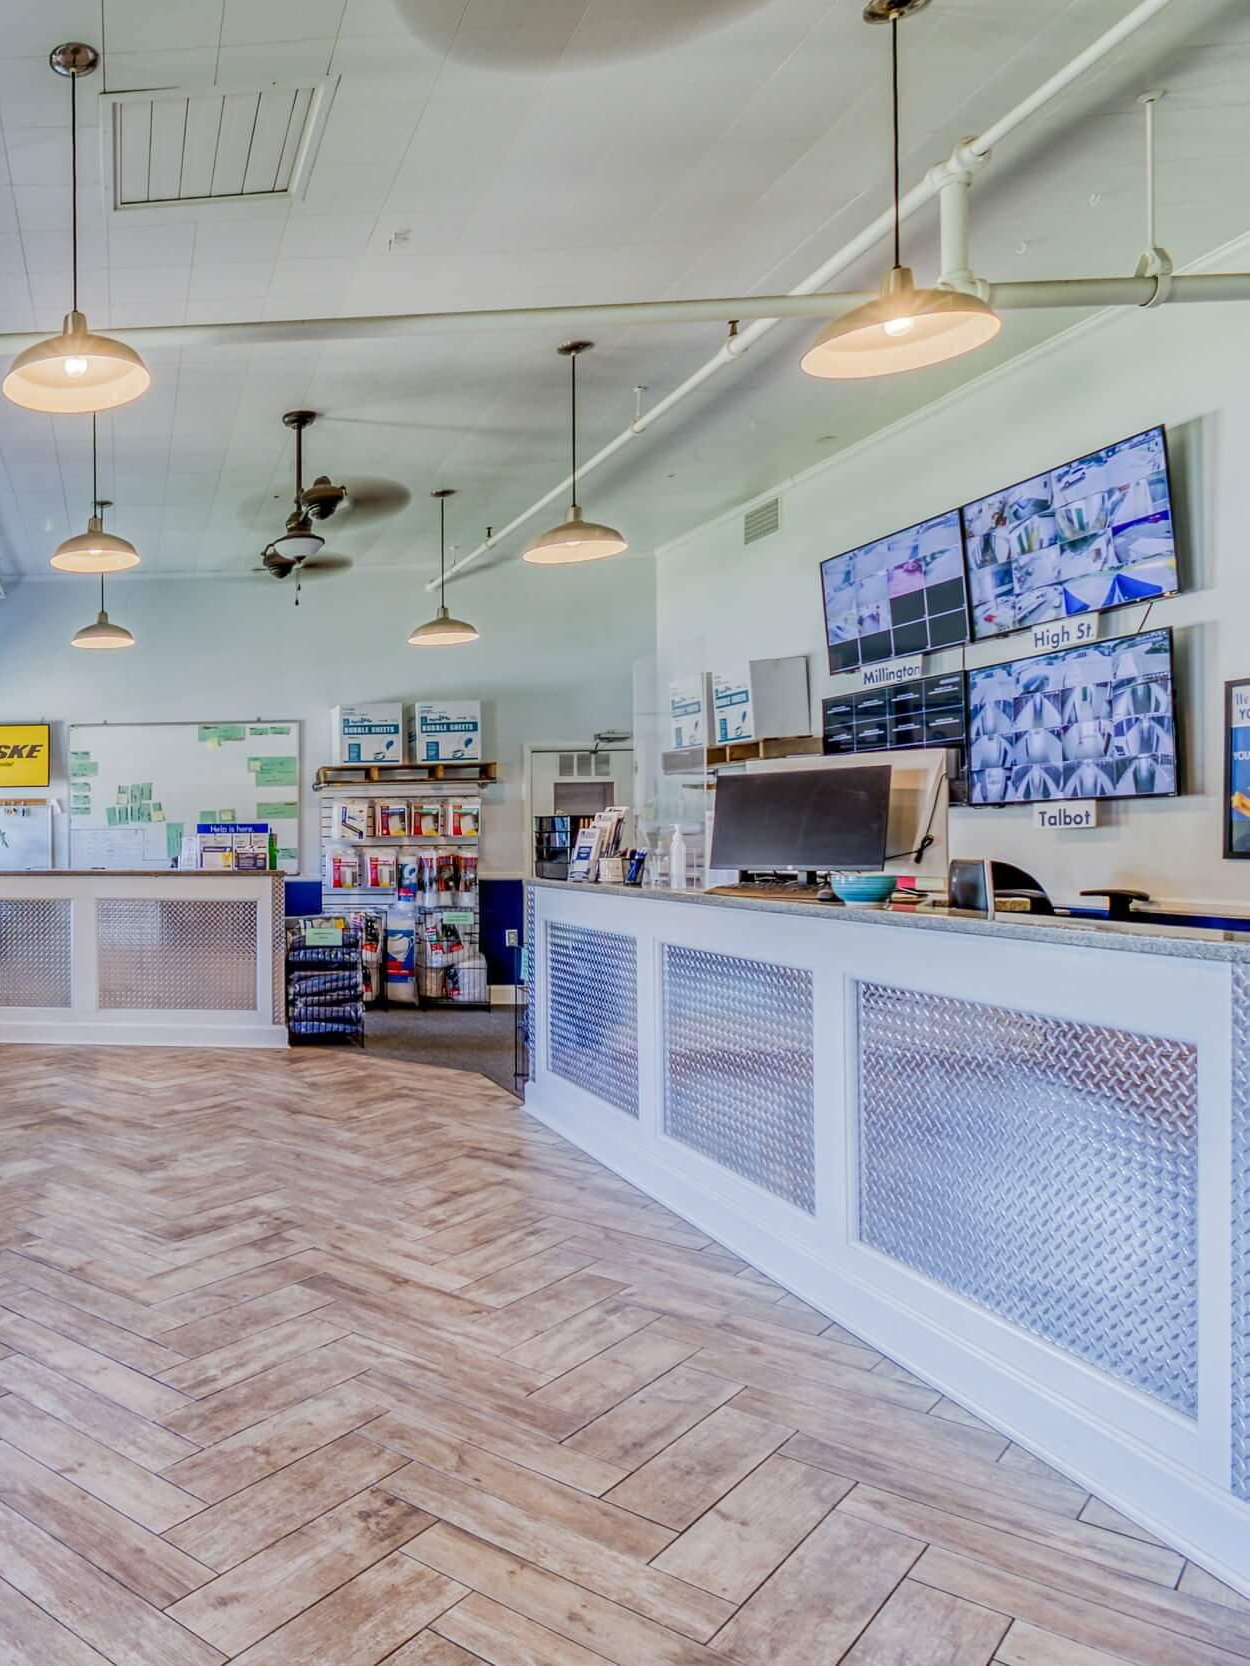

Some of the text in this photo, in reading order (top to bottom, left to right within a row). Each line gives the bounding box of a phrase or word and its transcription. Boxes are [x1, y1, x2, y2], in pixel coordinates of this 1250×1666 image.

[1033, 622, 1094, 648] High St.
[863, 665, 922, 685] Millington
[344, 725, 395, 734] BUBBLE SHEETS
[421, 723, 474, 732] BUBBLE SHEETS
[1038, 807, 1091, 827] Talbot
[210, 825, 255, 833] Help is here.
